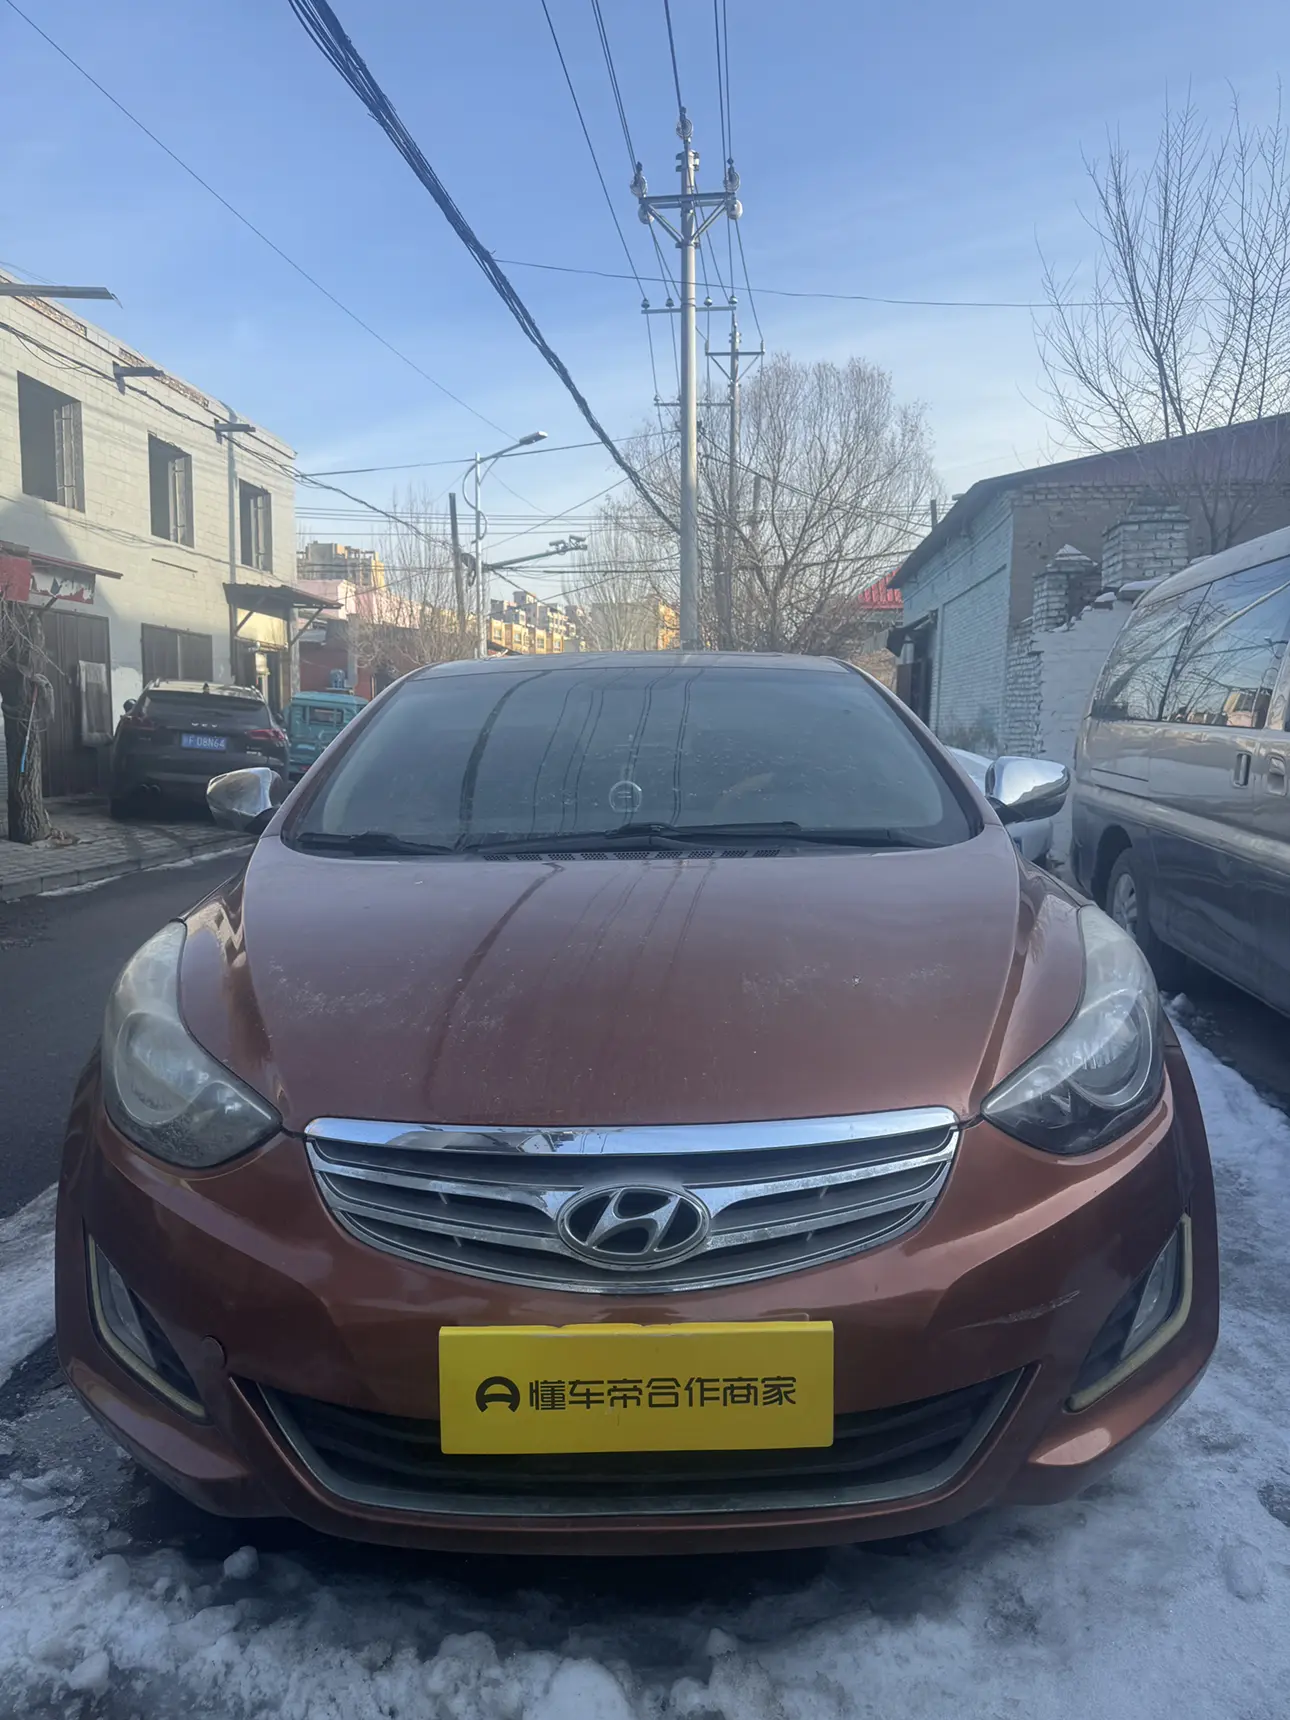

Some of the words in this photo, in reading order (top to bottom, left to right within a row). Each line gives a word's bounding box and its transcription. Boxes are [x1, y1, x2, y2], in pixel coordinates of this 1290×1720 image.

[529, 1375, 797, 1411] 懂车帝合作商家
